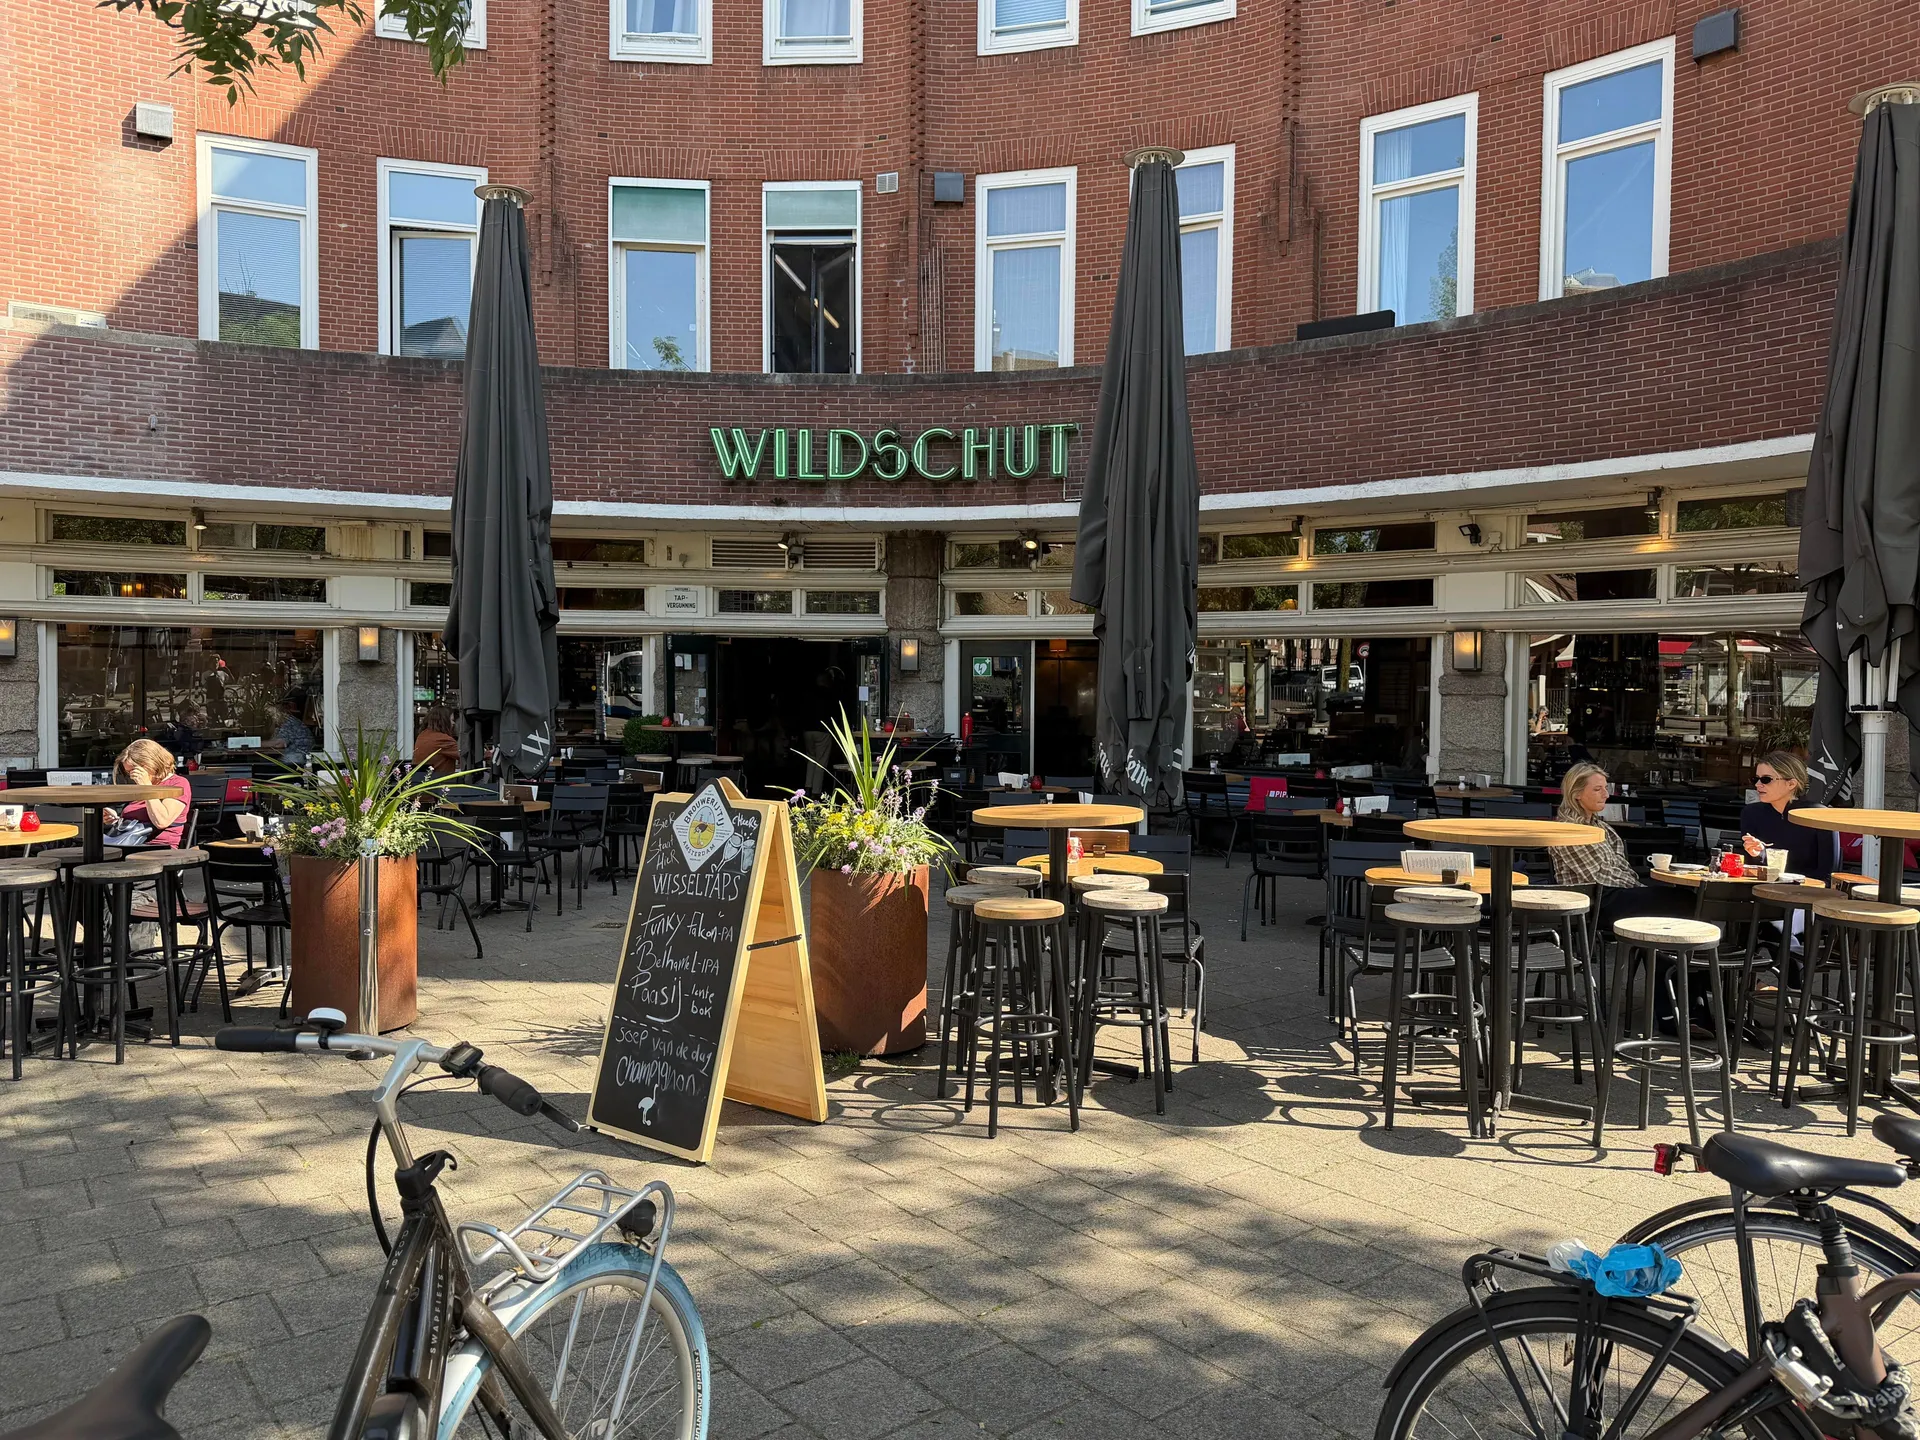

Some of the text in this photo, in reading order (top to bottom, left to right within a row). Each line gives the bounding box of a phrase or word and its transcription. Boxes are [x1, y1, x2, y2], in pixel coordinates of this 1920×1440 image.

[709, 422, 1080, 481] WILDSCHUT
[684, 797, 721, 824] BROUWERIJ
[683, 841, 716, 857] AMSTERDAM
[652, 873, 741, 901] WISSELTAPS
[615, 1055, 697, 1096] Champignon
[652, 1037, 674, 1057] van
[675, 1041, 689, 1060] de
[690, 1043, 713, 1077] dag
[429, 1273, 445, 1355] SWAPFIETS
